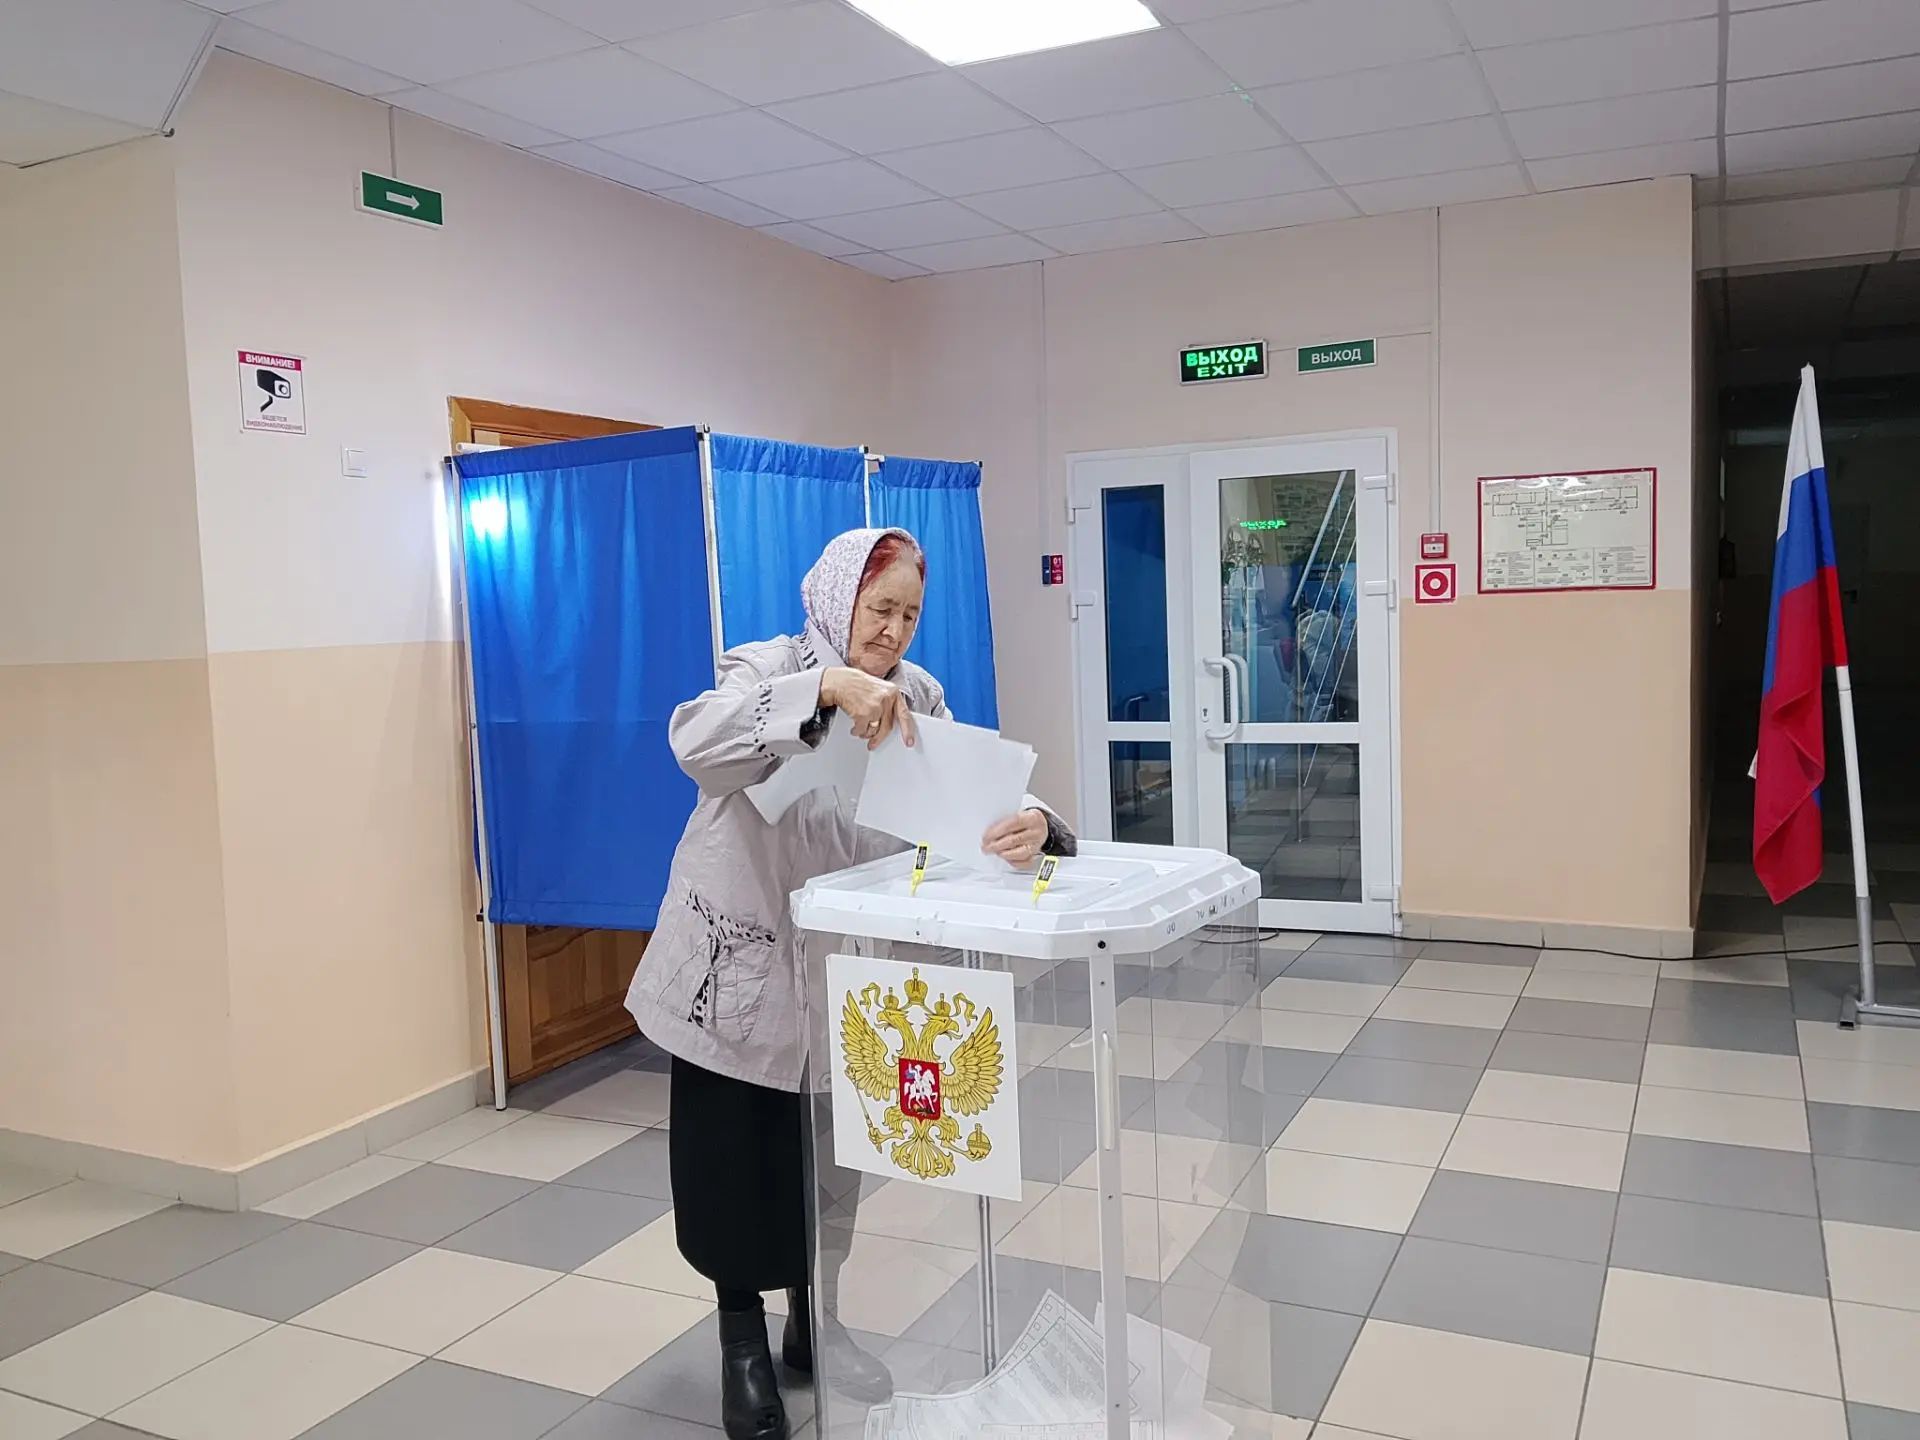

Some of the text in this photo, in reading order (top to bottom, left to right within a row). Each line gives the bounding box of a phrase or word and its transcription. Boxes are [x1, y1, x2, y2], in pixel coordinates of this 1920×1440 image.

[245, 353, 296, 368] ВНИМАНИЕ!
[1186, 346, 1258, 367] ВЫХОД
[1311, 348, 1362, 364] ВЫХОД
[1197, 363, 1248, 378] EXIT
